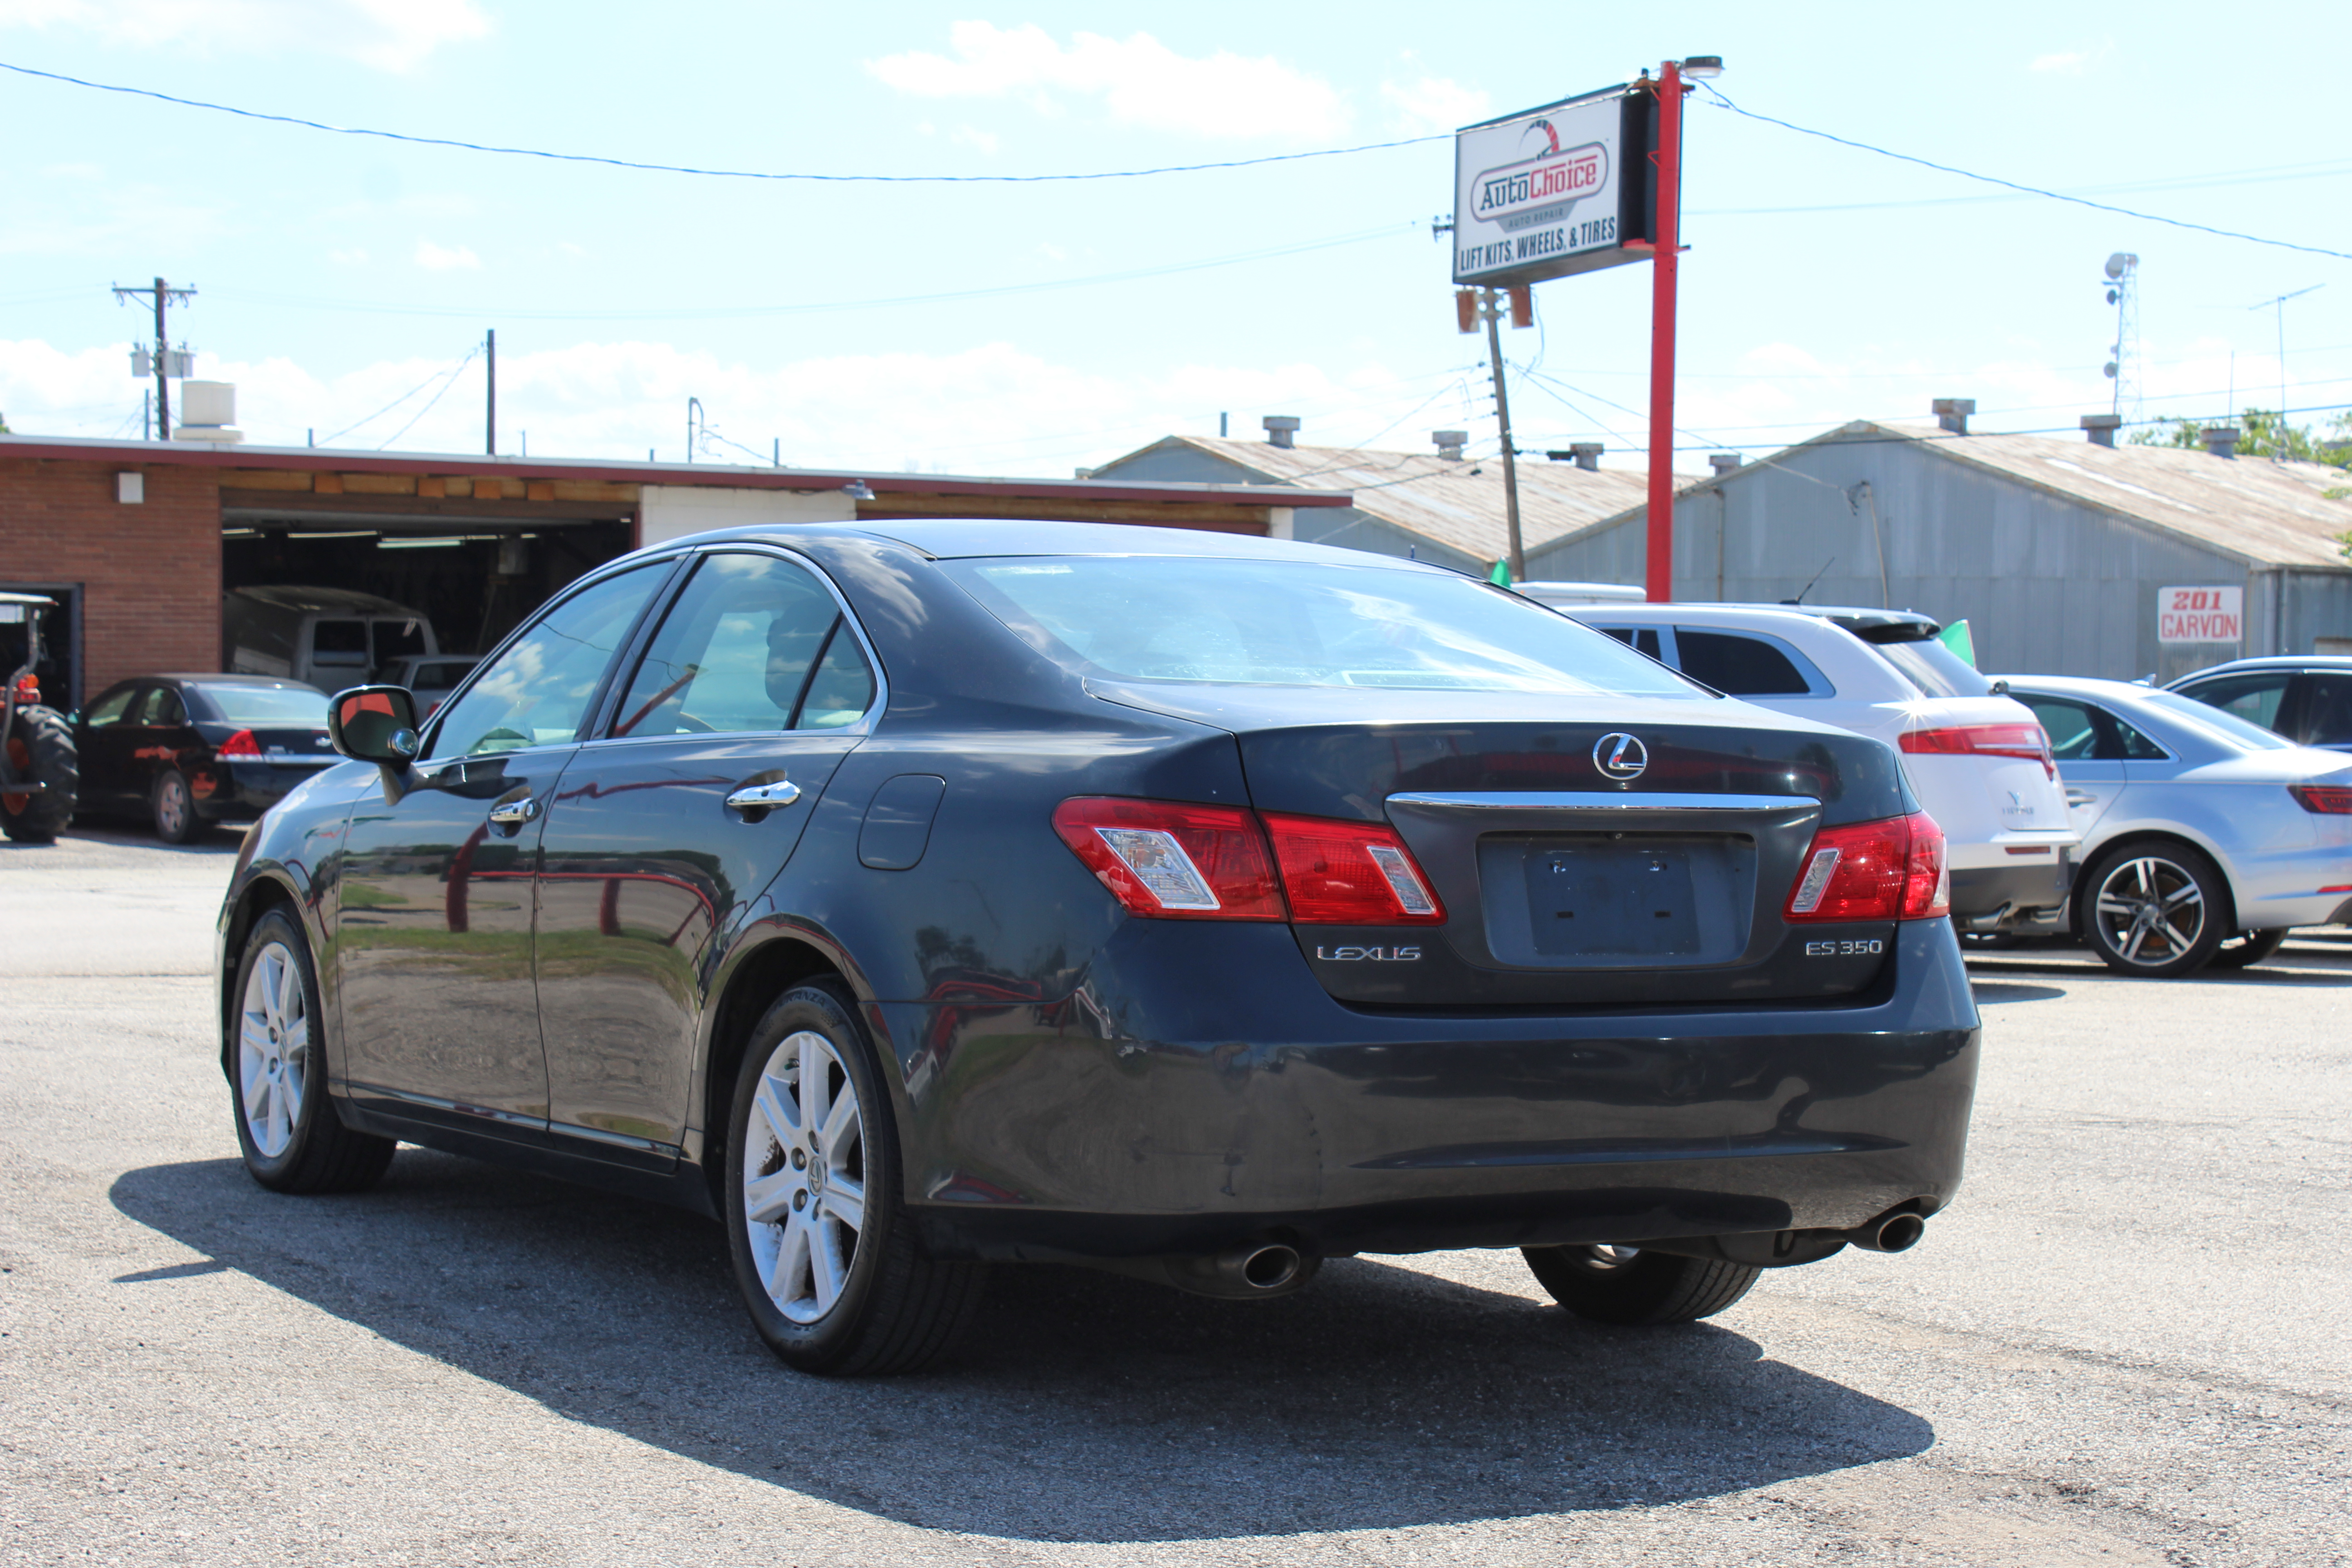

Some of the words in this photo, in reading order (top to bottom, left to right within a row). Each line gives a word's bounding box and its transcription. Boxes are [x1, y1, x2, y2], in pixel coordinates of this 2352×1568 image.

[1480, 154, 1598, 211] AutoChoice
[1509, 215, 1531, 227] AUTO
[1534, 207, 1564, 222] REPAIR
[1460, 246, 1483, 271] LIFT
[1485, 240, 1514, 266] KITS,
[1517, 228, 1566, 260] WHEELS,
[1569, 227, 1578, 248] &
[1581, 216, 1616, 245] TIRES
[2172, 591, 2222, 611] 201
[2161, 614, 2237, 638] GARVON
[1317, 946, 1421, 961] LEXUS
[1806, 941, 1836, 956] ES
[1840, 940, 1883, 955] 350
